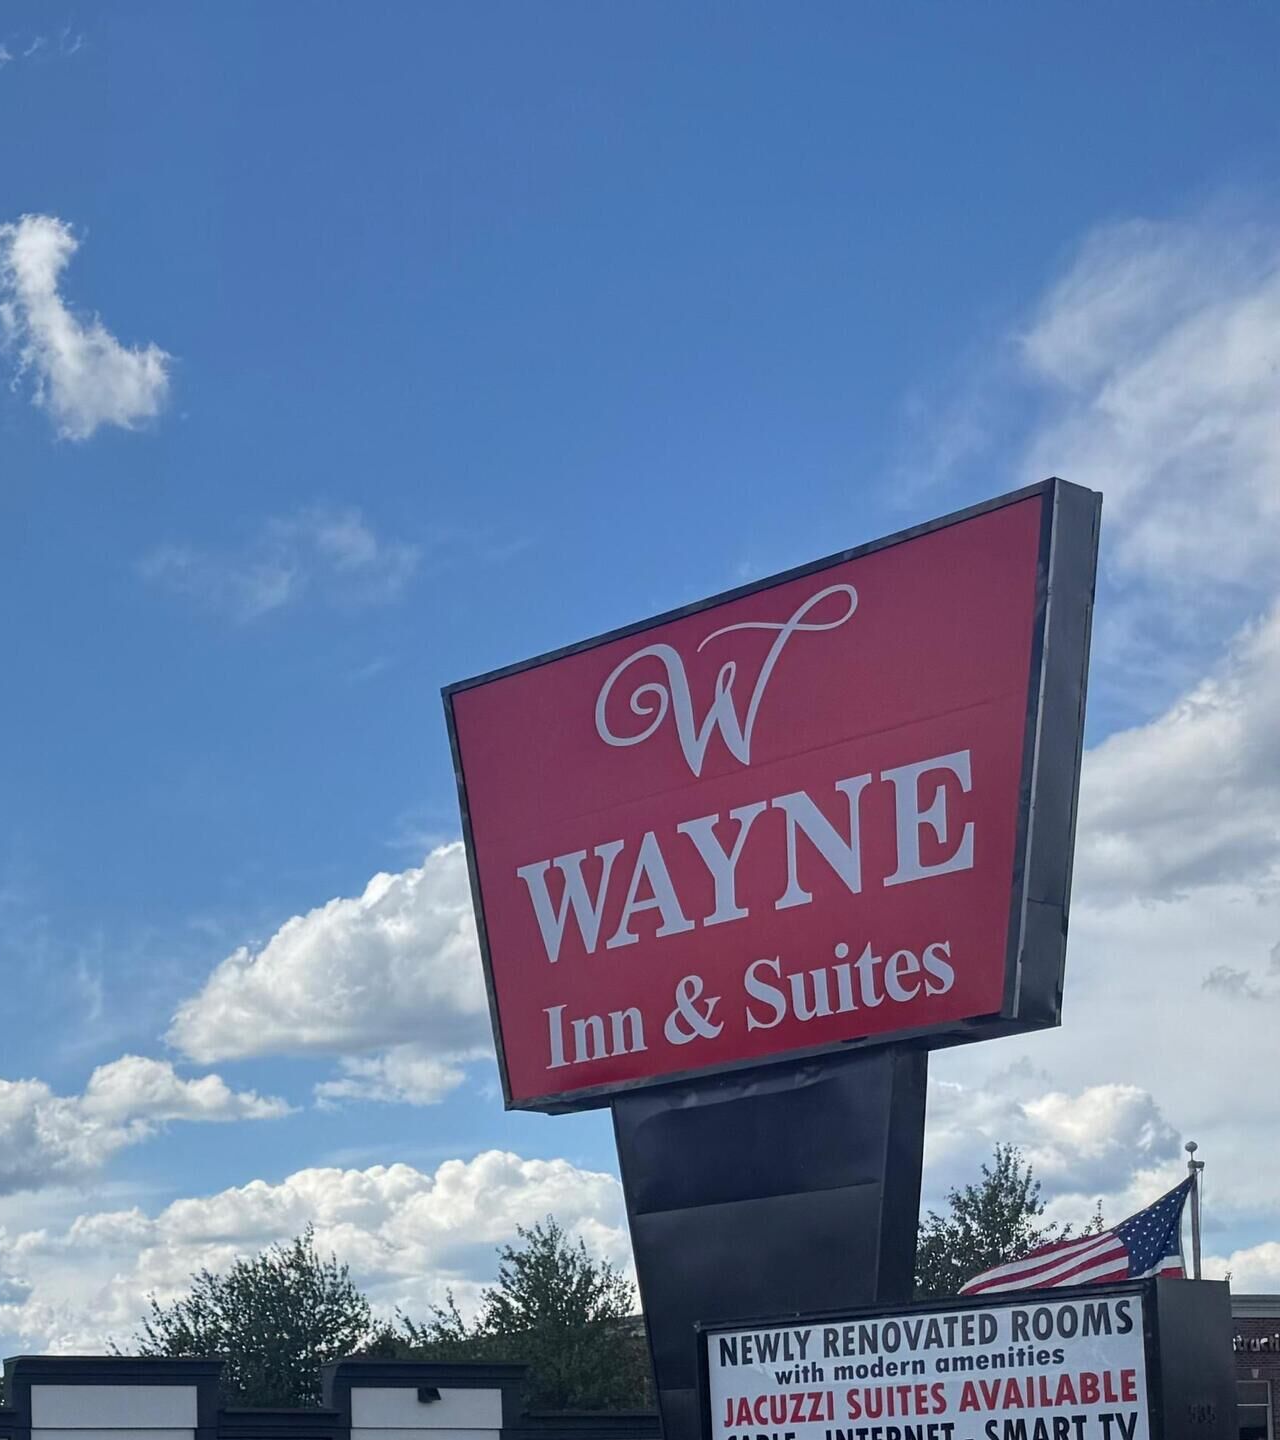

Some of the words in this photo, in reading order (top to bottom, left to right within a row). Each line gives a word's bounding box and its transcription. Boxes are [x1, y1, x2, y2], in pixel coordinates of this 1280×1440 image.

[595, 583, 859, 778] W
[517, 749, 976, 963] WAYNE
[542, 1004, 648, 1070] Inn
[663, 974, 725, 1045] &
[745, 939, 955, 1032] Suites
[719, 1329, 812, 1367] NEWLY
[823, 1313, 998, 1358] RENOVATED
[1011, 1300, 1133, 1343] ROOMS
[775, 1362, 824, 1385] with
[834, 1356, 925, 1381] modern
[935, 1345, 1065, 1373] amenities
[724, 1391, 834, 1428] JACUZZI
[846, 1382, 947, 1420] SUITES
[959, 1369, 1138, 1413] AVAILABLE
